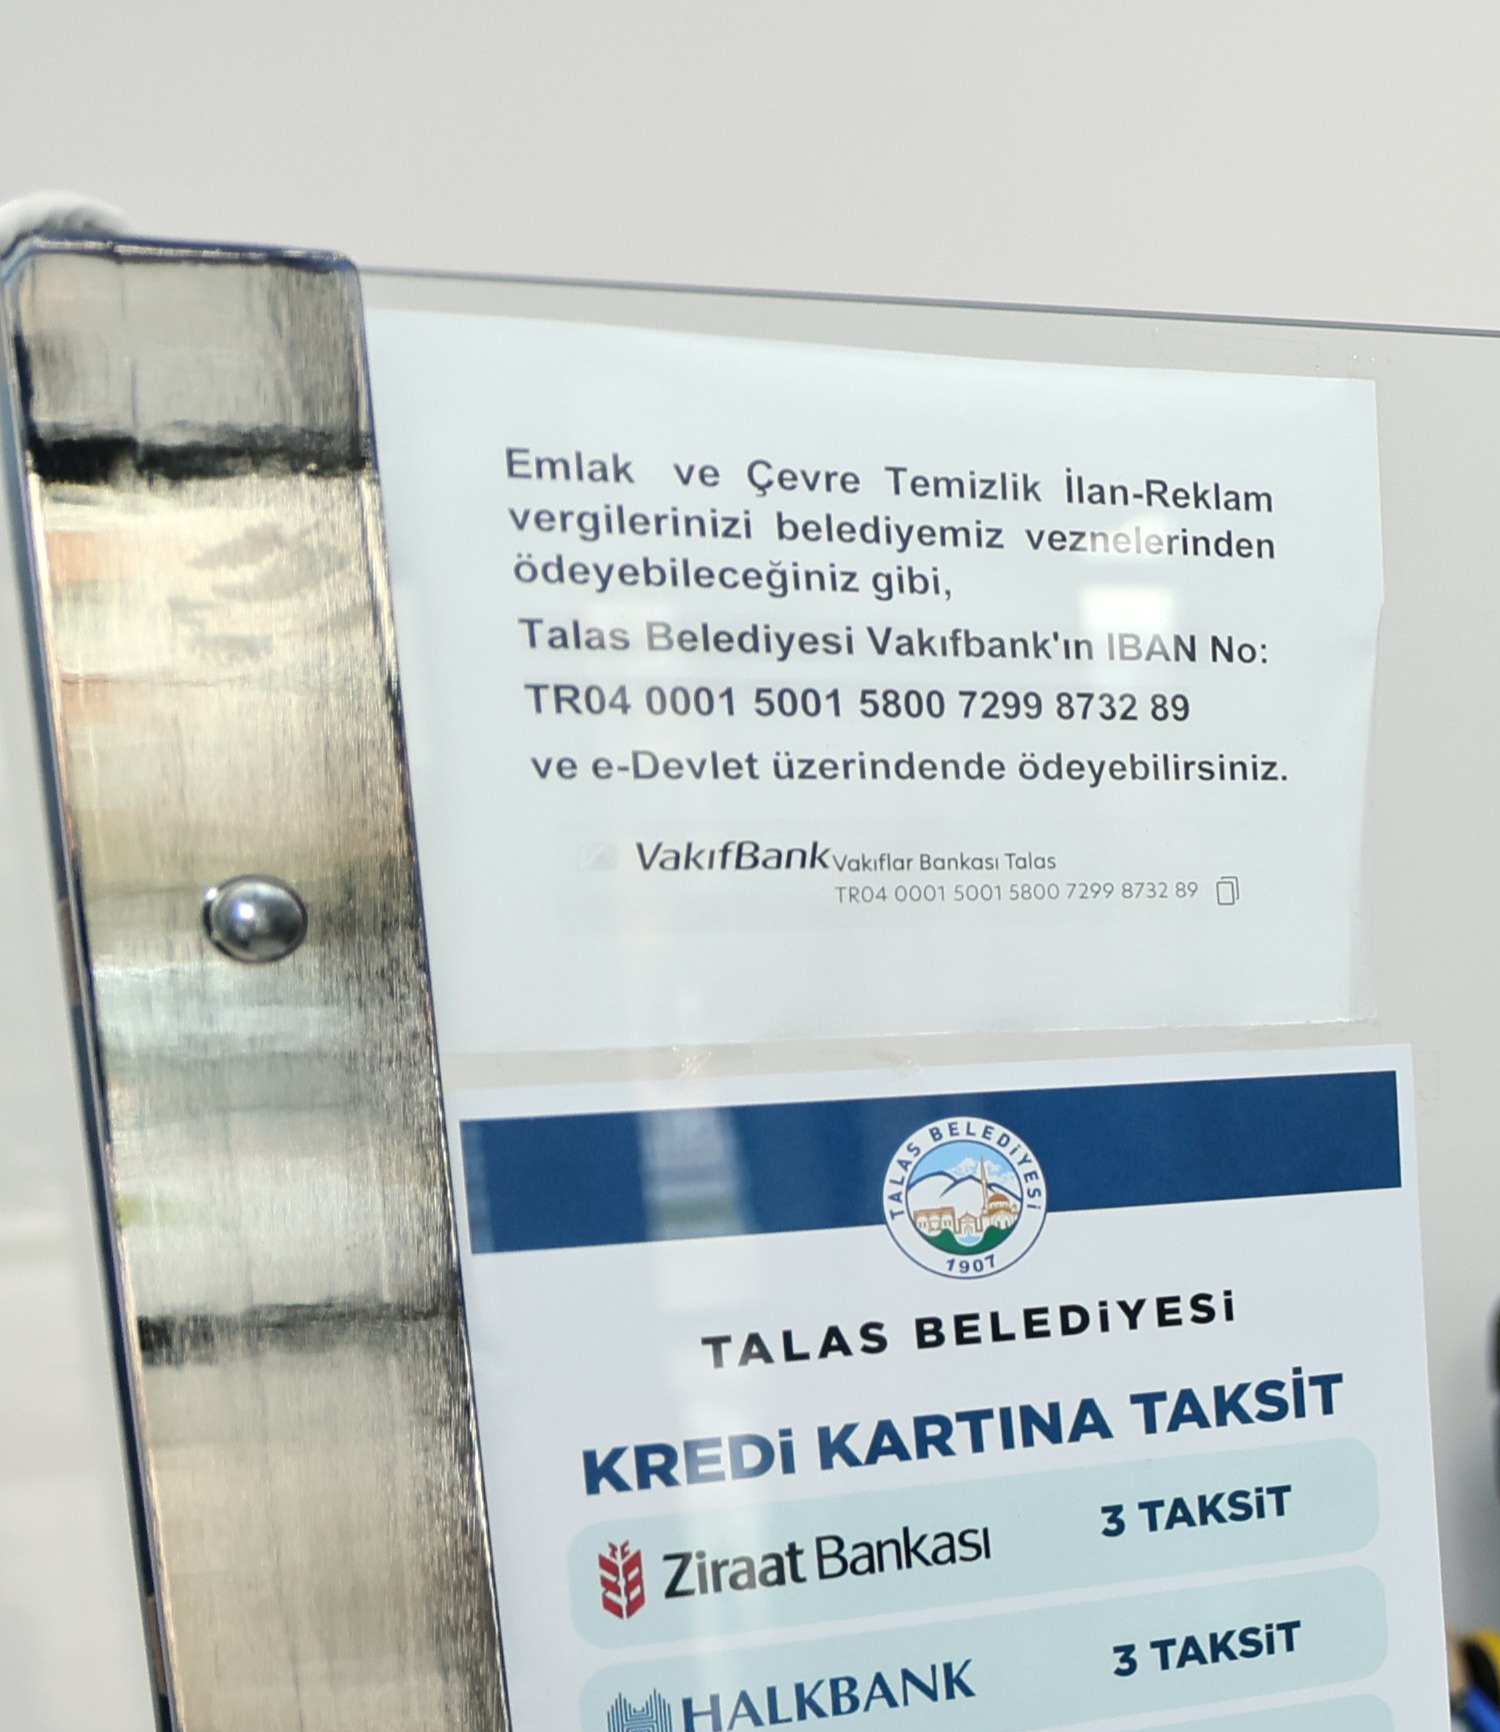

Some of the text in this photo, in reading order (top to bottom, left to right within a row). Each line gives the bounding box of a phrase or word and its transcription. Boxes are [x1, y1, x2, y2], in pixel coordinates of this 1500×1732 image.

[505, 447, 1273, 513] Emlak ve Çevre Temizlik İlan-Reklam
[508, 503, 1275, 560] vergilerinizi belediyemiz veznelerinden
[513, 553, 952, 602] ödeyebileceğiniz gibi,
[517, 618, 1268, 664] Talas Belediyesi Vakıfbank'ın IBAN No:
[523, 683, 1190, 722] TR04 0001 5001 5800 7299 8732 89
[531, 750, 1288, 789] ve e-Devlet üzerindende ödeyebilirsiniz.
[636, 840, 830, 871] VakıfBank
[831, 851, 1057, 873] Vakıflar Bankası Talas
[834, 881, 1199, 904] TR04 0001 5001 5800 7299 8732 89
[888, 1142, 922, 1220] TALAS
[945, 1254, 996, 1274] 1907
[701, 1321, 888, 1368] TALAS
[817, 1397, 1115, 1471] KARTINA
[1129, 1365, 1344, 1435] TAKSİT
[1100, 1503, 1126, 1538] 3
[662, 1525, 991, 1599] Ziraat Bankası
[1112, 1643, 1138, 1678] 3
